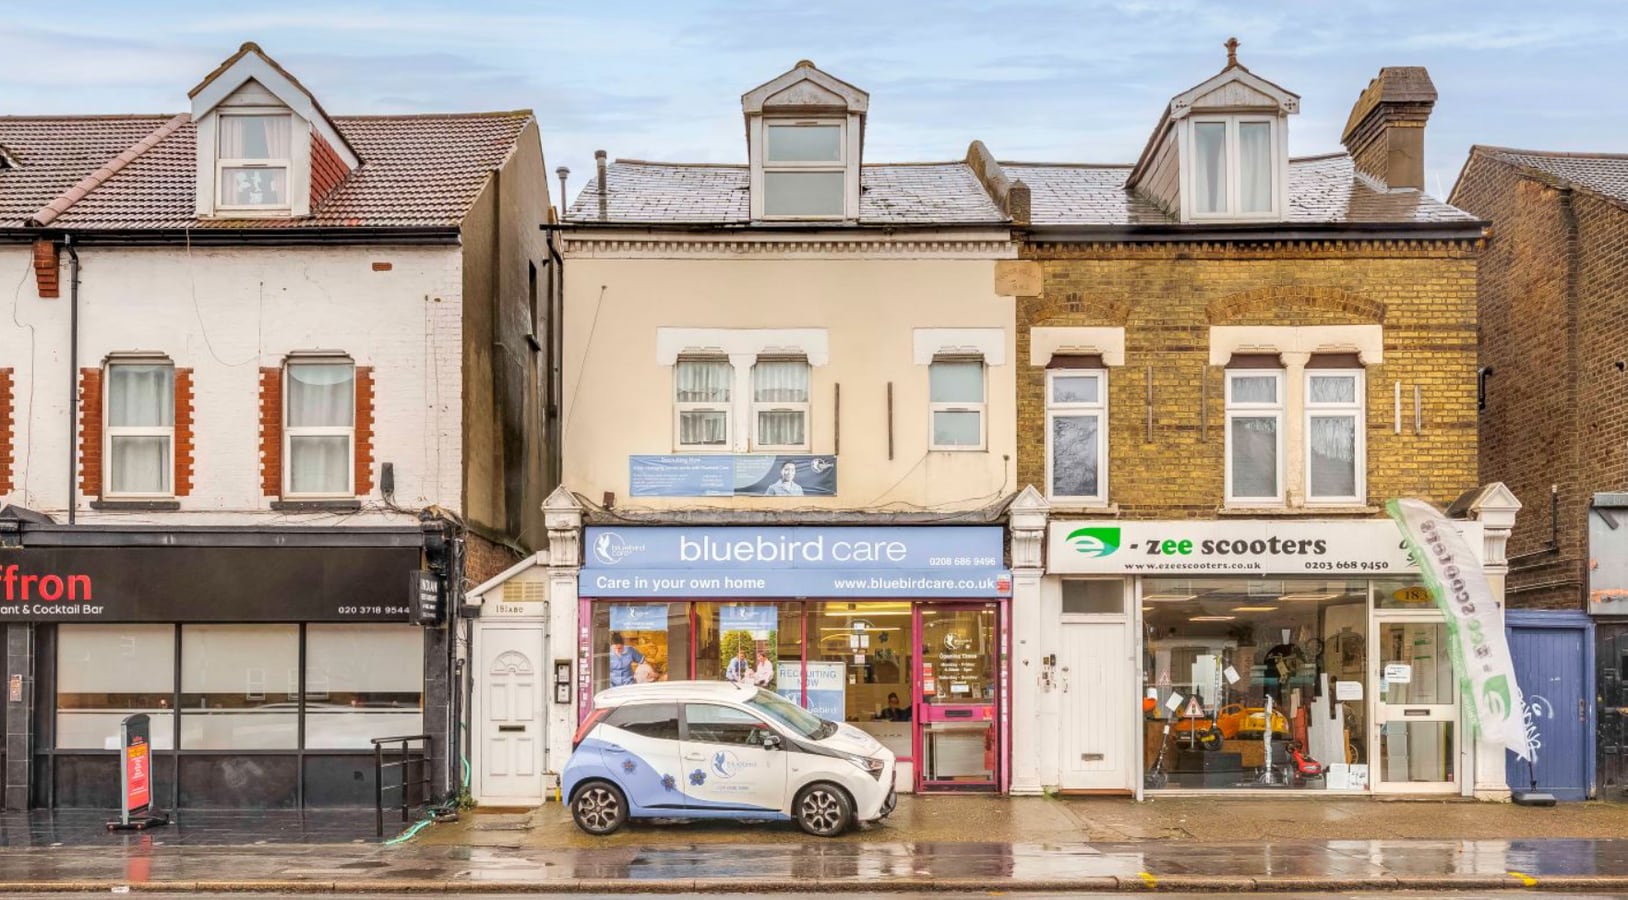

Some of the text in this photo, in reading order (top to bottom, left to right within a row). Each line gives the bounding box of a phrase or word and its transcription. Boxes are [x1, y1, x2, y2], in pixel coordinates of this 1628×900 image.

[680, 535, 907, 561] bluebird care
[1146, 539, 1193, 555] zee
[1201, 536, 1327, 555] scooters
[929, 557, 952, 566] 0208
[974, 557, 996, 566] 9496
[1124, 562, 1262, 570] www.ezeescooters.co.uk
[1304, 561, 1389, 570] 0203 668 9450
[0, 564, 92, 601] fron
[596, 576, 766, 592] Care in your own home
[834, 577, 995, 589] www.bluebirdcare.co.uk
[22, 604, 31, 615] &
[32, 604, 80, 615] Cocktail
[83, 604, 105, 615] Bar
[338, 606, 410, 615] 020 3718 9544
[780, 669, 837, 679] RECUITING
